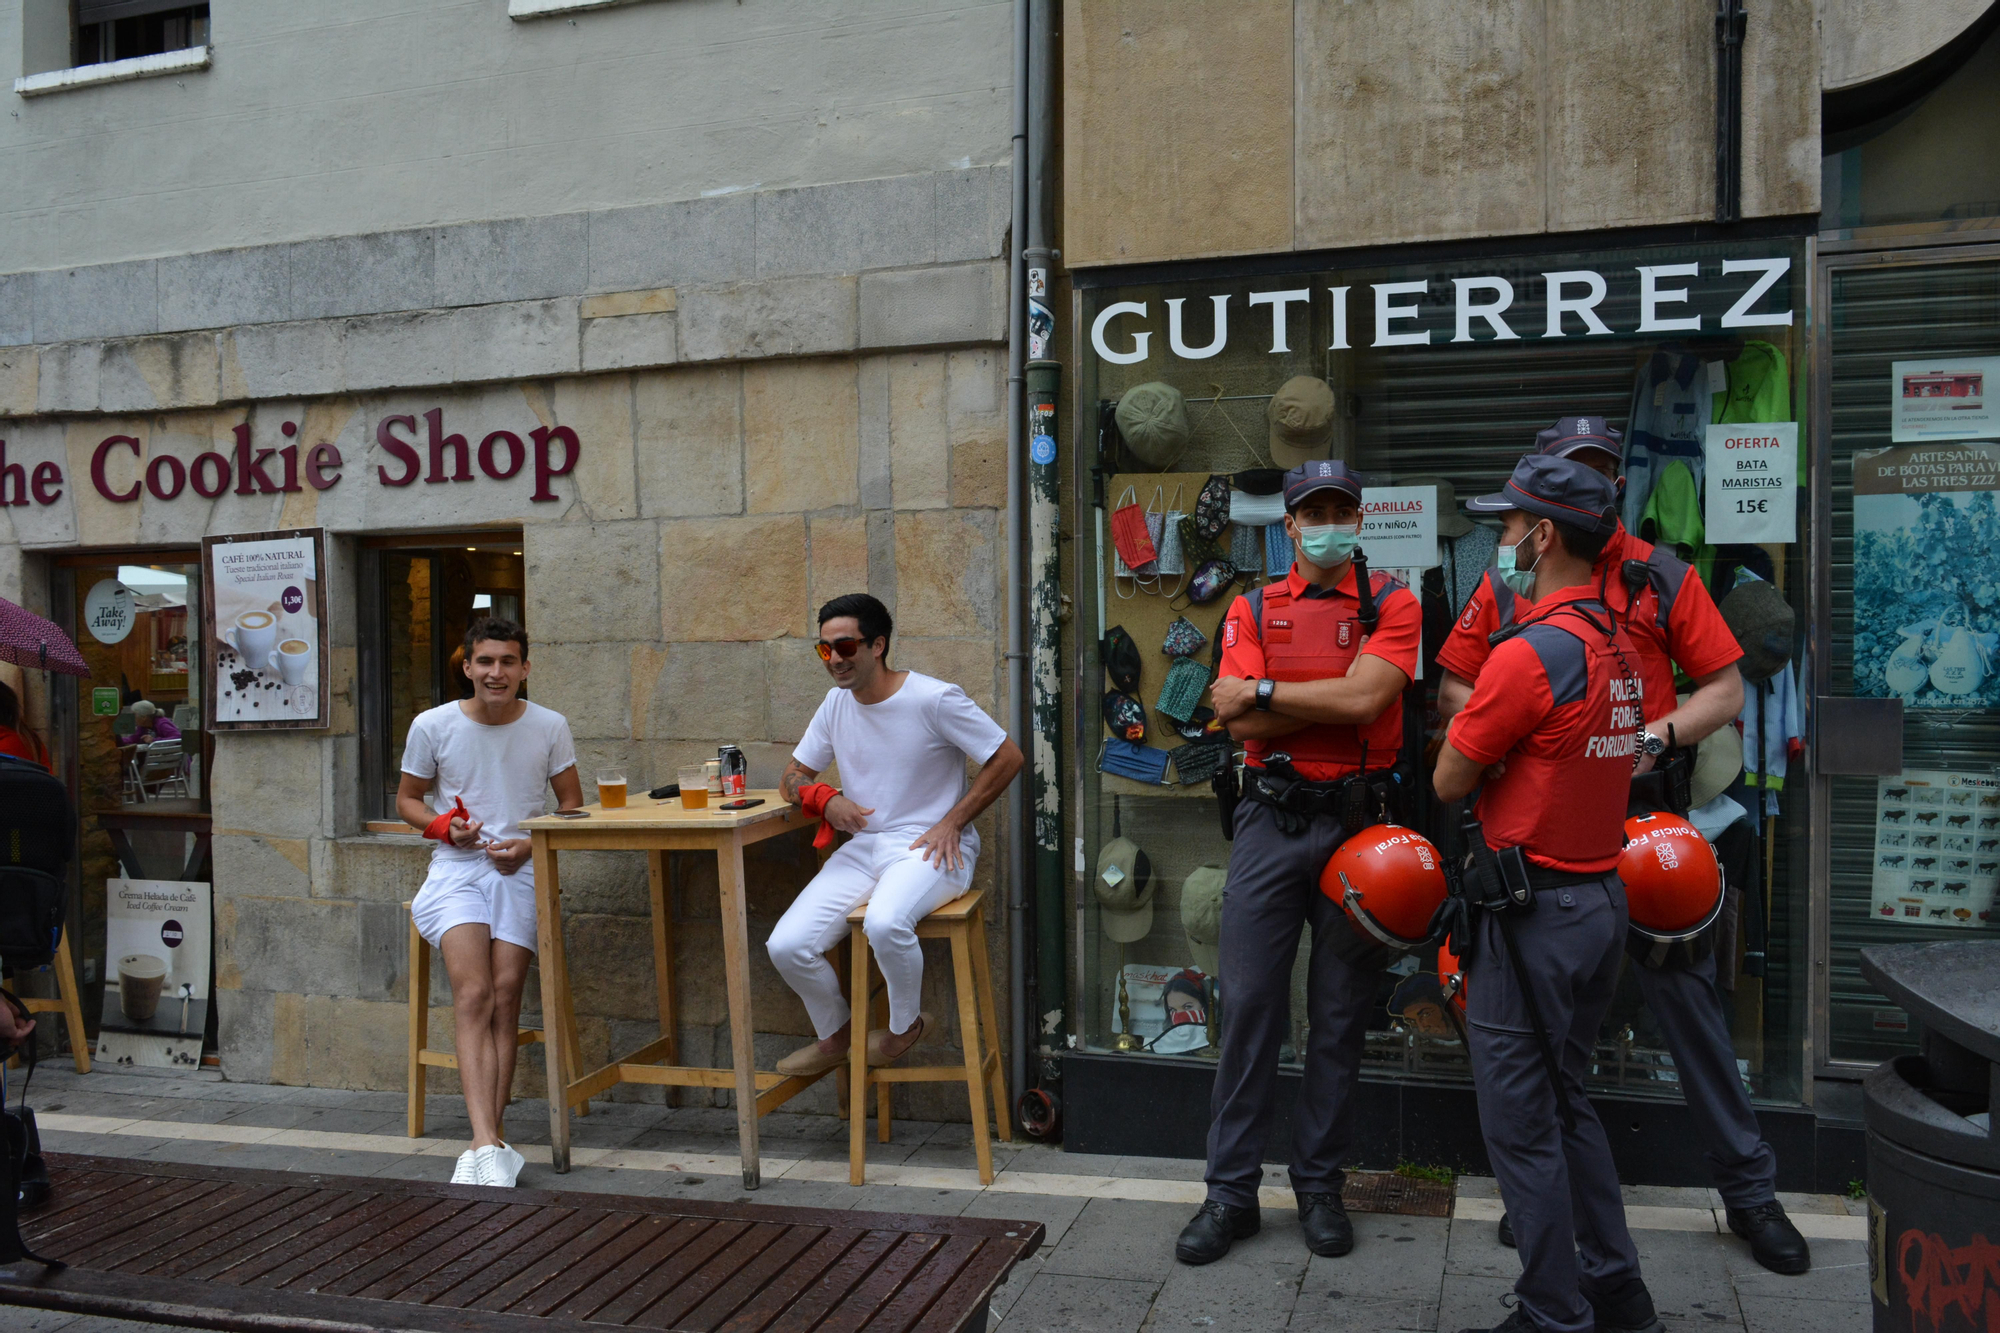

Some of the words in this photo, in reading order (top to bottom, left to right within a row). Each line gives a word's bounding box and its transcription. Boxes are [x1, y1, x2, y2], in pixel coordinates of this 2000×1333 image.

[1091, 257, 1793, 365] GUTIERREZ
[1725, 437, 1780, 449] OFERTA
[91, 421, 343, 503] Cookie
[377, 407, 580, 502] Shop
[1909, 450, 1989, 463] ARTESANIA
[1736, 460, 1768, 470] BATA
[1878, 466, 1896, 477] DE
[1900, 463, 1945, 476] BOTAS
[1948, 462, 1986, 474] PARA
[1722, 477, 1782, 488] MARISTAS
[1902, 477, 1928, 488] LAS
[1931, 475, 1968, 487] TRES
[1971, 474, 1996, 486] ZZZ
[1736, 500, 1768, 513] 15€
[1378, 522, 1383, 530] Y
[1385, 520, 1417, 530] NIÑO/A
[222, 553, 245, 564] CAFÉ
[246, 553, 264, 562] 100%
[265, 550, 305, 561] NATURAL
[224, 565, 245, 574] Tueste
[246, 562, 279, 572] tradicional
[280, 561, 304, 570] italiano
[235, 573, 256, 584] Special
[256, 573, 276, 581] Italian
[277, 571, 294, 580] Roast
[284, 595, 302, 606] 1,30€
[99, 606, 124, 618] Take
[91, 616, 127, 630] Away!
[1650, 826, 1699, 839] Policía
[1374, 834, 1411, 855] Foral
[1622, 833, 1650, 852] For
[118, 891, 142, 900] Crema
[144, 891, 168, 901] Helada
[170, 893, 179, 902] de
[180, 893, 197, 903] Café
[126, 901, 141, 910] Iced
[142, 901, 163, 912] Coffee
[164, 902, 189, 912] Cream
